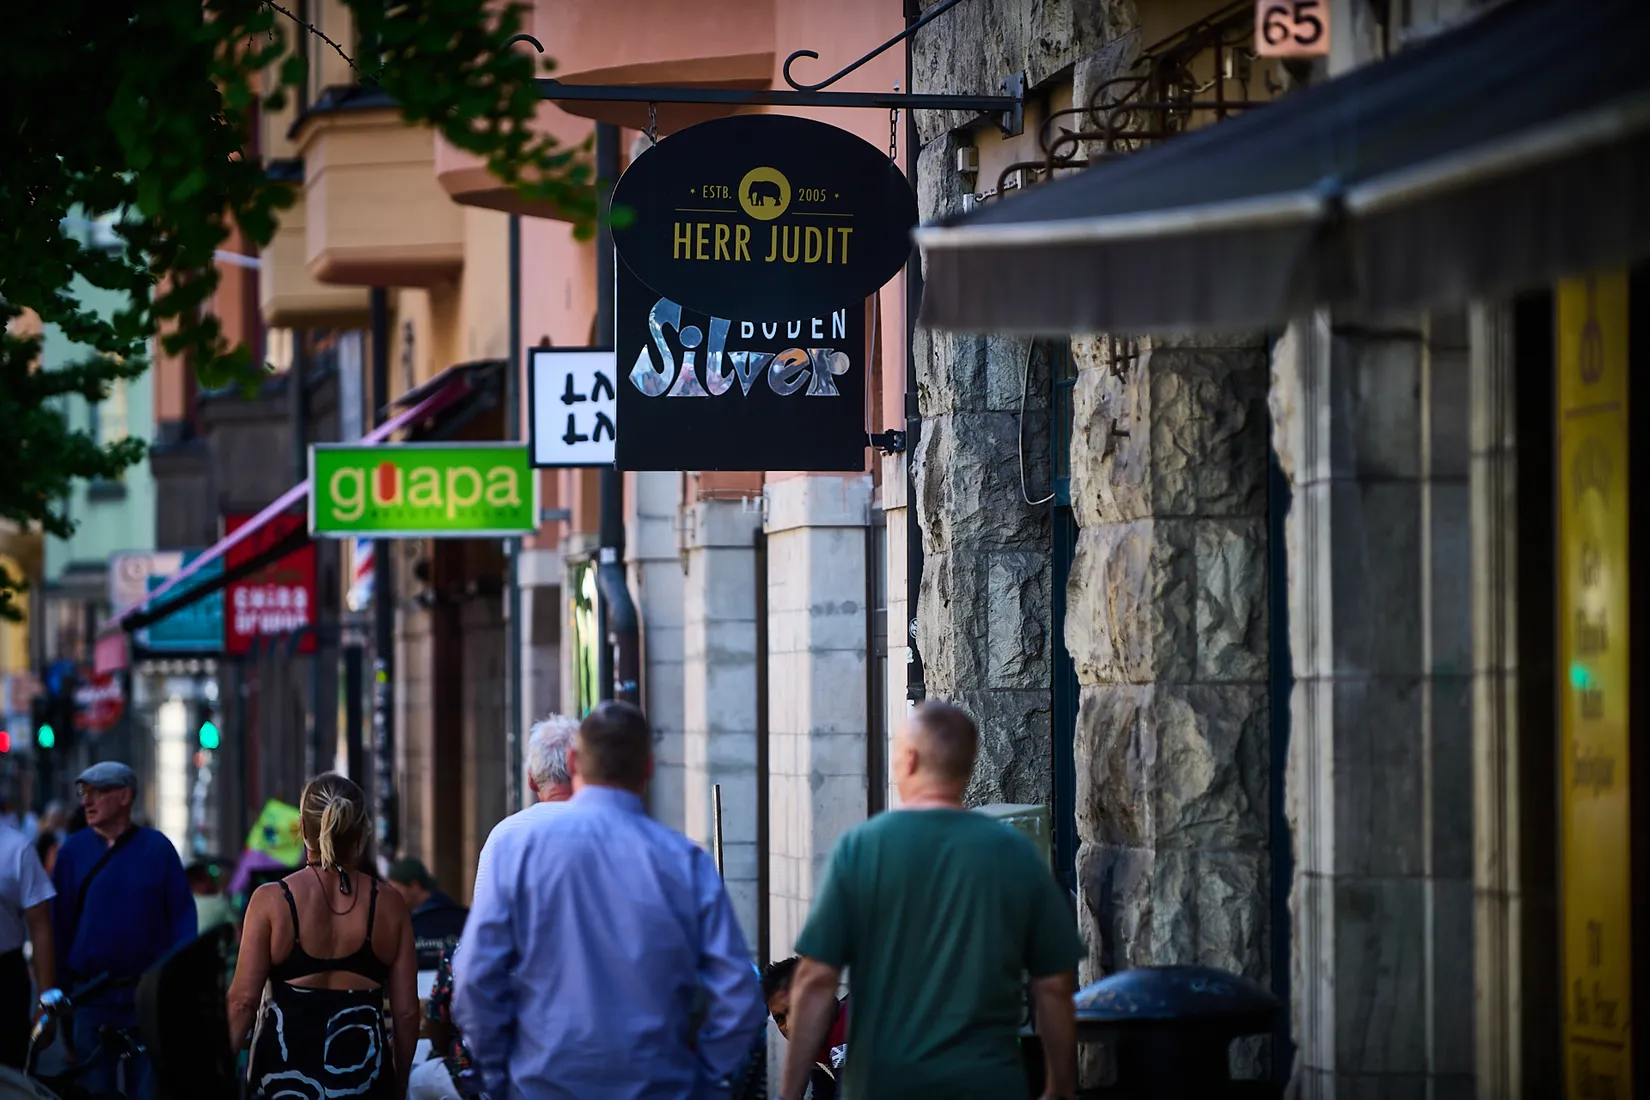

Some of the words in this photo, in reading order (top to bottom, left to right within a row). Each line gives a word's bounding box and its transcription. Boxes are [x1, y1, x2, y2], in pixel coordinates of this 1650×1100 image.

[1263, 0, 1324, 46] 65
[702, 185, 732, 200] ESTB.
[798, 188, 827, 202] 2005
[673, 222, 751, 262] HERR
[765, 225, 854, 265] JUDIT
[628, 297, 851, 398] Silver
[329, 464, 522, 522] guapa
